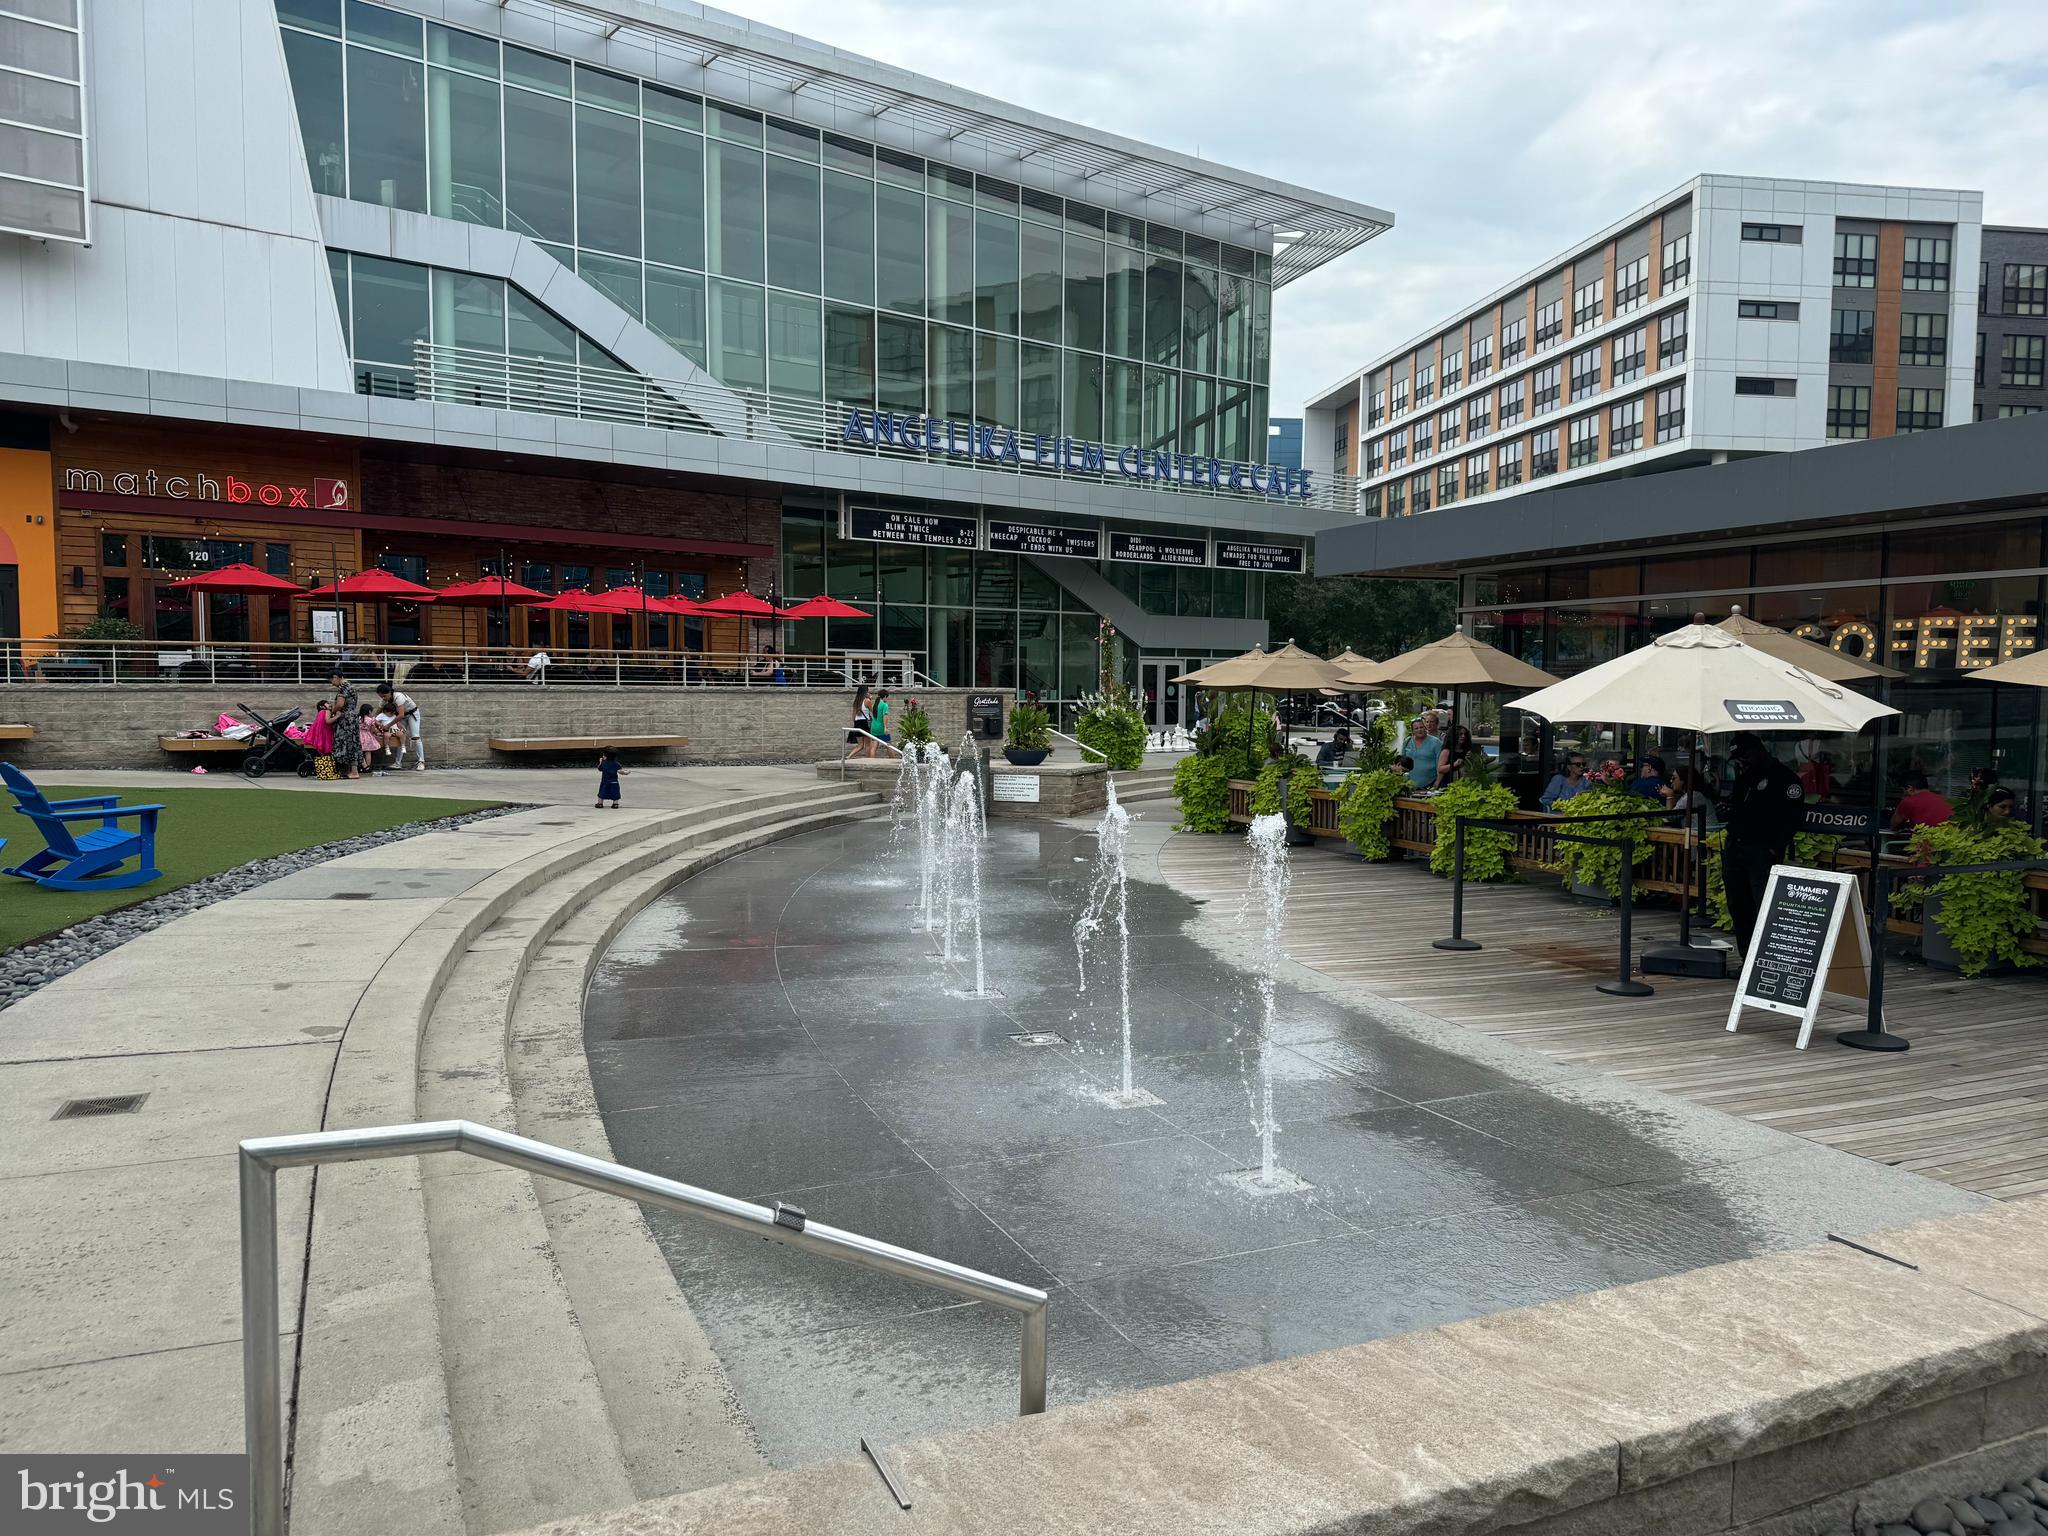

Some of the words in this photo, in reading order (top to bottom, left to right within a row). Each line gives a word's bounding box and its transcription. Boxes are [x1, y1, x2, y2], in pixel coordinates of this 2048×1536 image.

[843, 408, 1021, 463] ANGELIKA
[1035, 434, 1106, 472] FILM
[1118, 446, 1221, 488] CENTER
[1229, 464, 1242, 490] &
[1251, 465, 1313, 498] CAFE
[66, 468, 308, 508] matchbox
[891, 514, 900, 522] ON
[904, 515, 921, 524] SALE
[924, 517, 939, 526] NOW
[885, 522, 905, 531] BLINK
[909, 524, 930, 534] TWICE
[1008, 525, 1045, 536] DESPICABLE
[1047, 529, 1056, 537] ME
[872, 529, 905, 540] BETWEEN
[908, 532, 921, 541] THE
[924, 534, 954, 544] TEMPLES
[990, 532, 1019, 541] KNEECAP
[1027, 535, 1052, 544] CUCKOO
[1066, 538, 1096, 548] TWISTERS
[1020, 542, 1028, 550] IT
[1030, 543, 1046, 552] ENDS
[1048, 545, 1063, 553] WITH
[1065, 546, 1073, 554] US
[1128, 544, 1156, 553] DEADPOOL
[1165, 547, 1194, 556] WOLVERINE
[188, 551, 209, 562] 120
[1115, 550, 1154, 560] BORDERLANDS
[1222, 551, 1246, 560] REWARDS
[1238, 559, 1251, 567] FREE
[1740, 704, 1781, 712] mosaic
[1805, 811, 1868, 826] mosaic
[1786, 883, 1829, 896] SUMMER
[1779, 901, 1807, 910] FOUNTAIN
